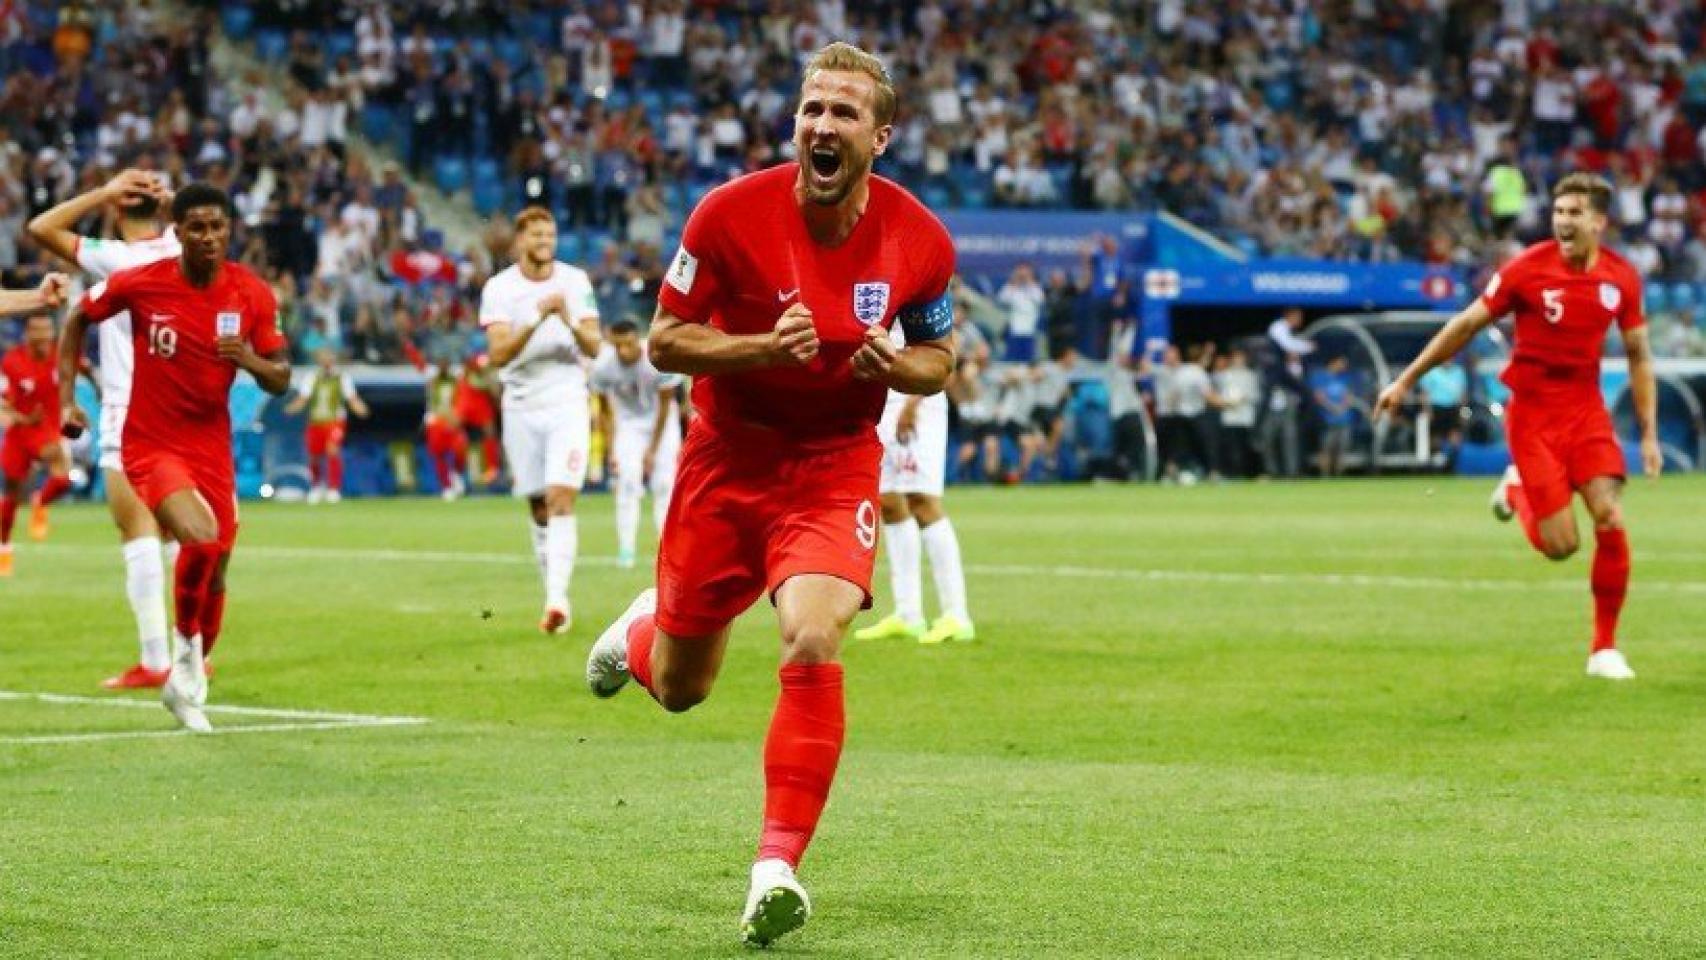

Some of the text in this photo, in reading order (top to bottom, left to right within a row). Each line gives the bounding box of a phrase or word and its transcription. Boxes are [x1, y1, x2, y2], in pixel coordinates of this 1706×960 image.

[1542, 290, 1564, 324] 5
[148, 323, 178, 358] 19
[856, 499, 876, 550] 9
